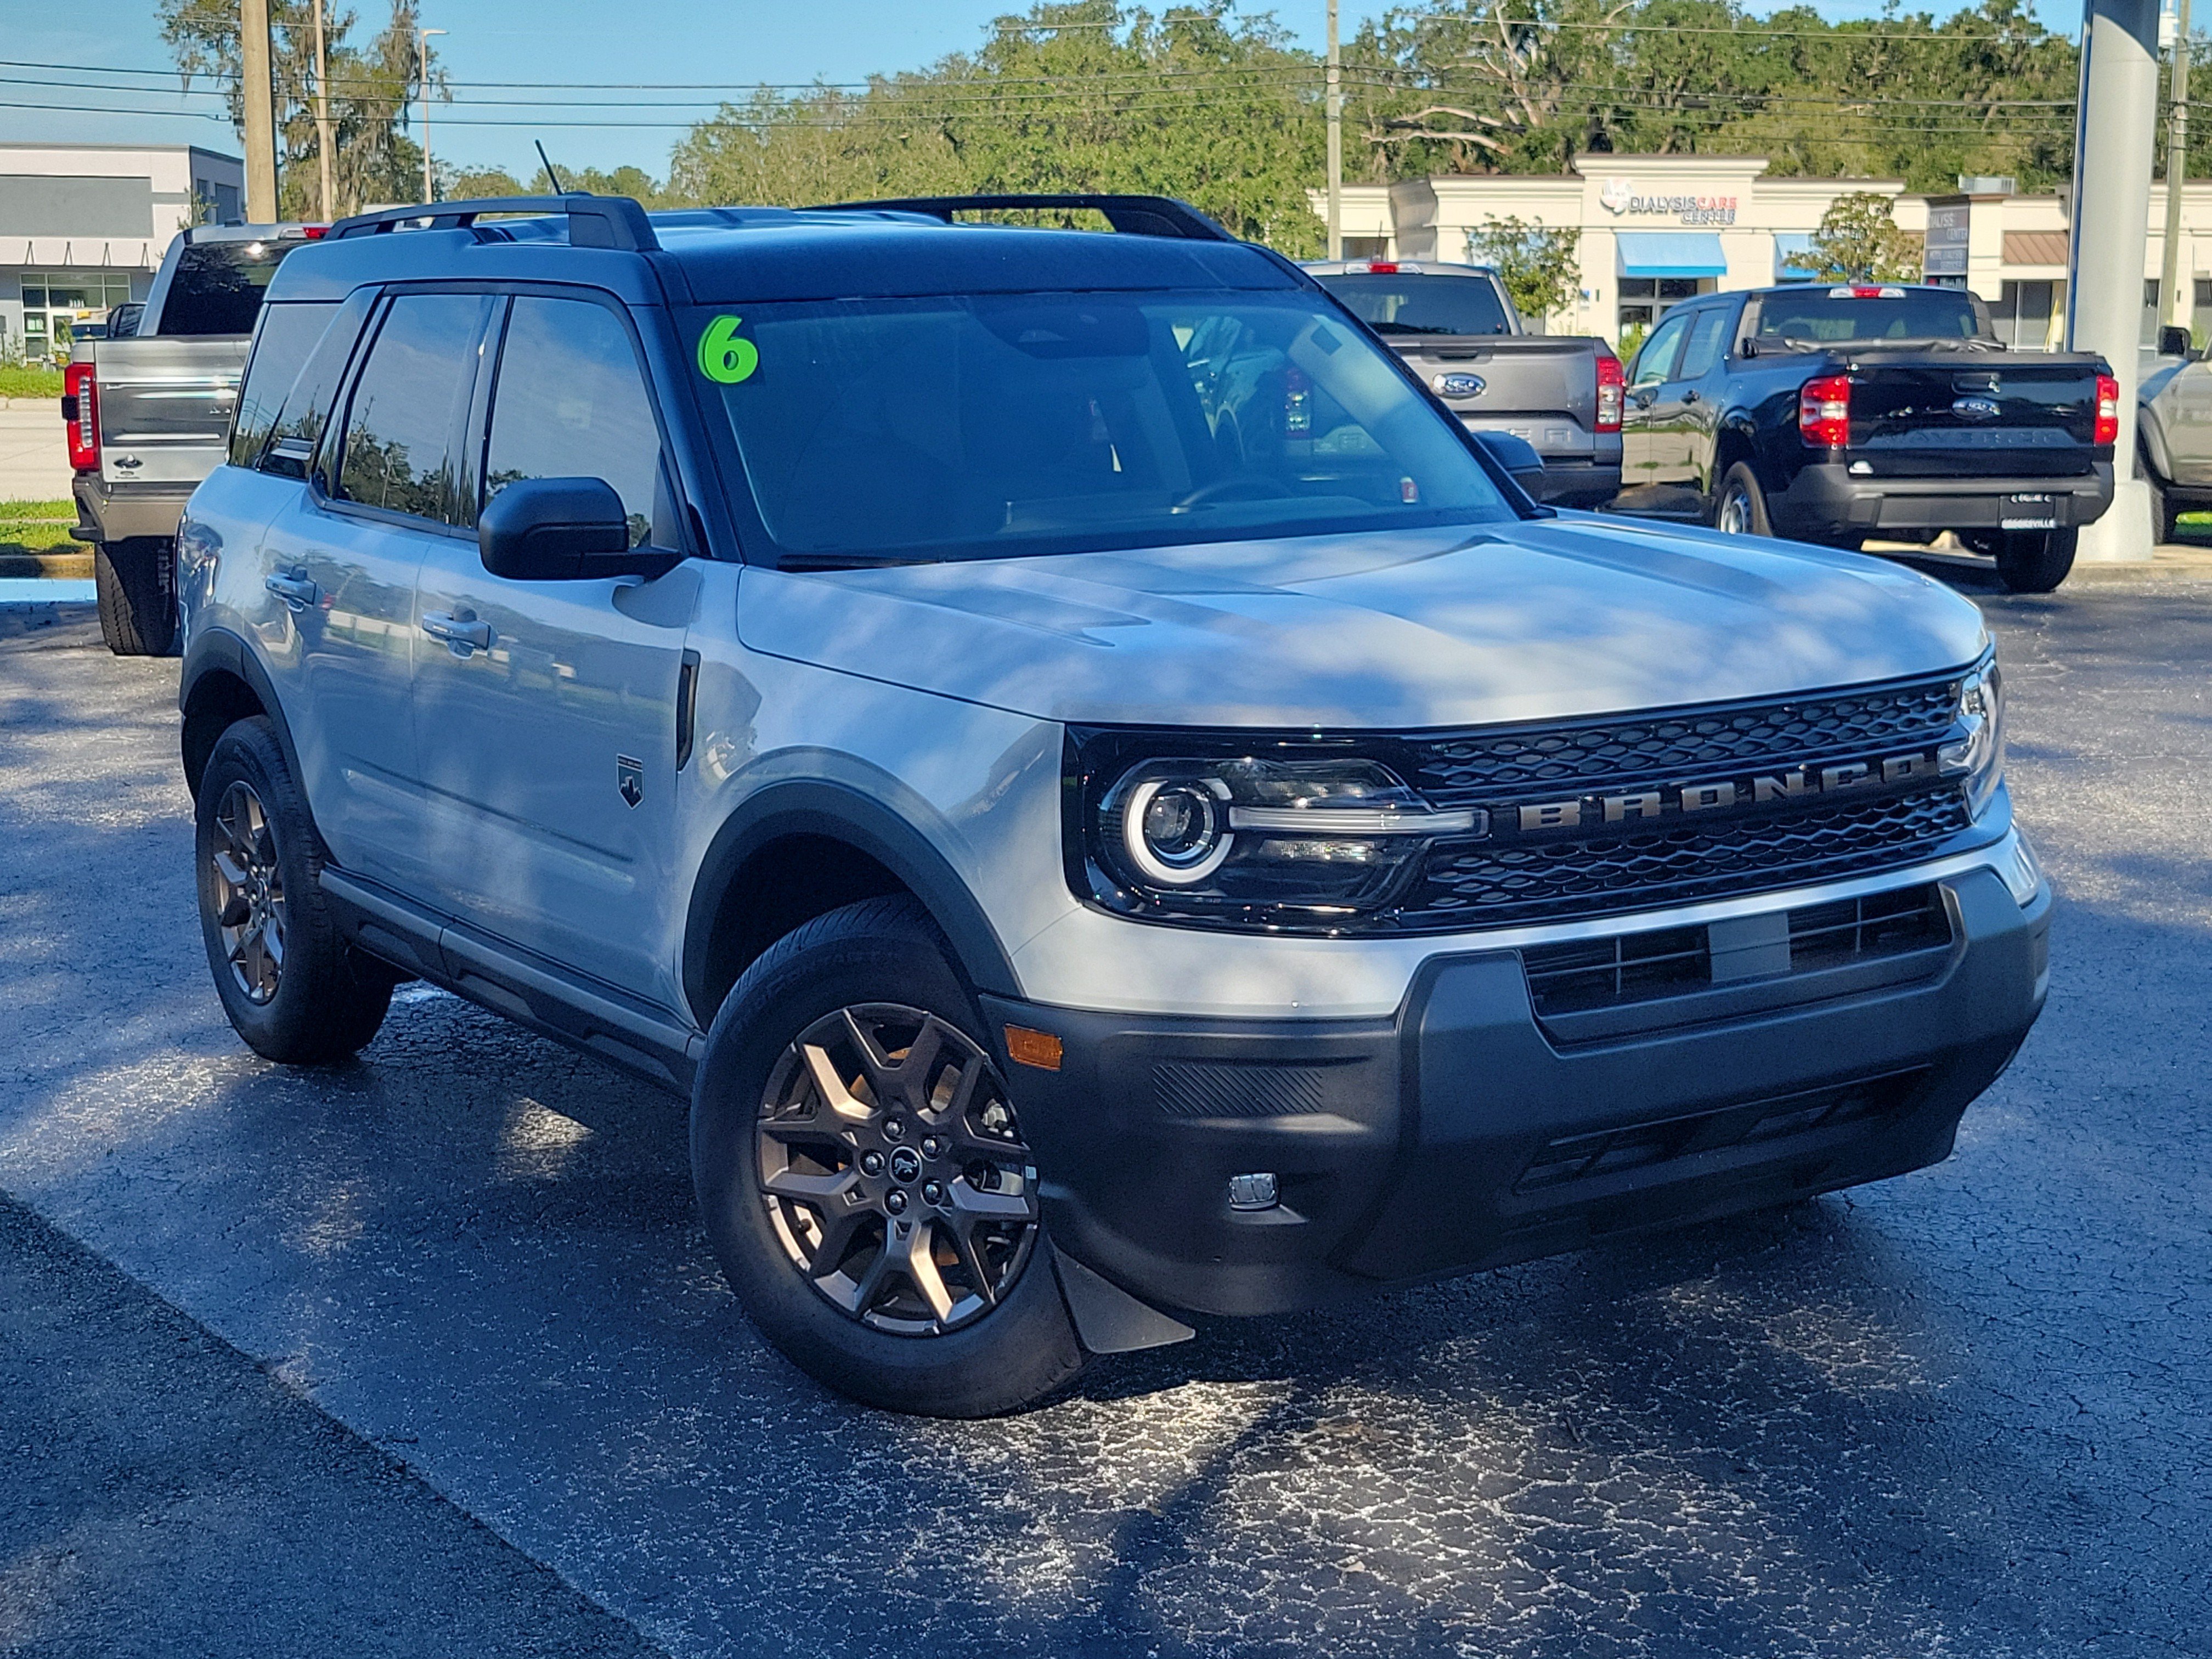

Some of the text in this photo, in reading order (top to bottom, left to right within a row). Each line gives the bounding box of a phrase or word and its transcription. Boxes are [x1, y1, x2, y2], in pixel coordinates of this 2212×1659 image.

[1681, 209, 1735, 223] CENTER
[698, 315, 758, 383] 6
[1520, 753, 1926, 831] BRONCO
